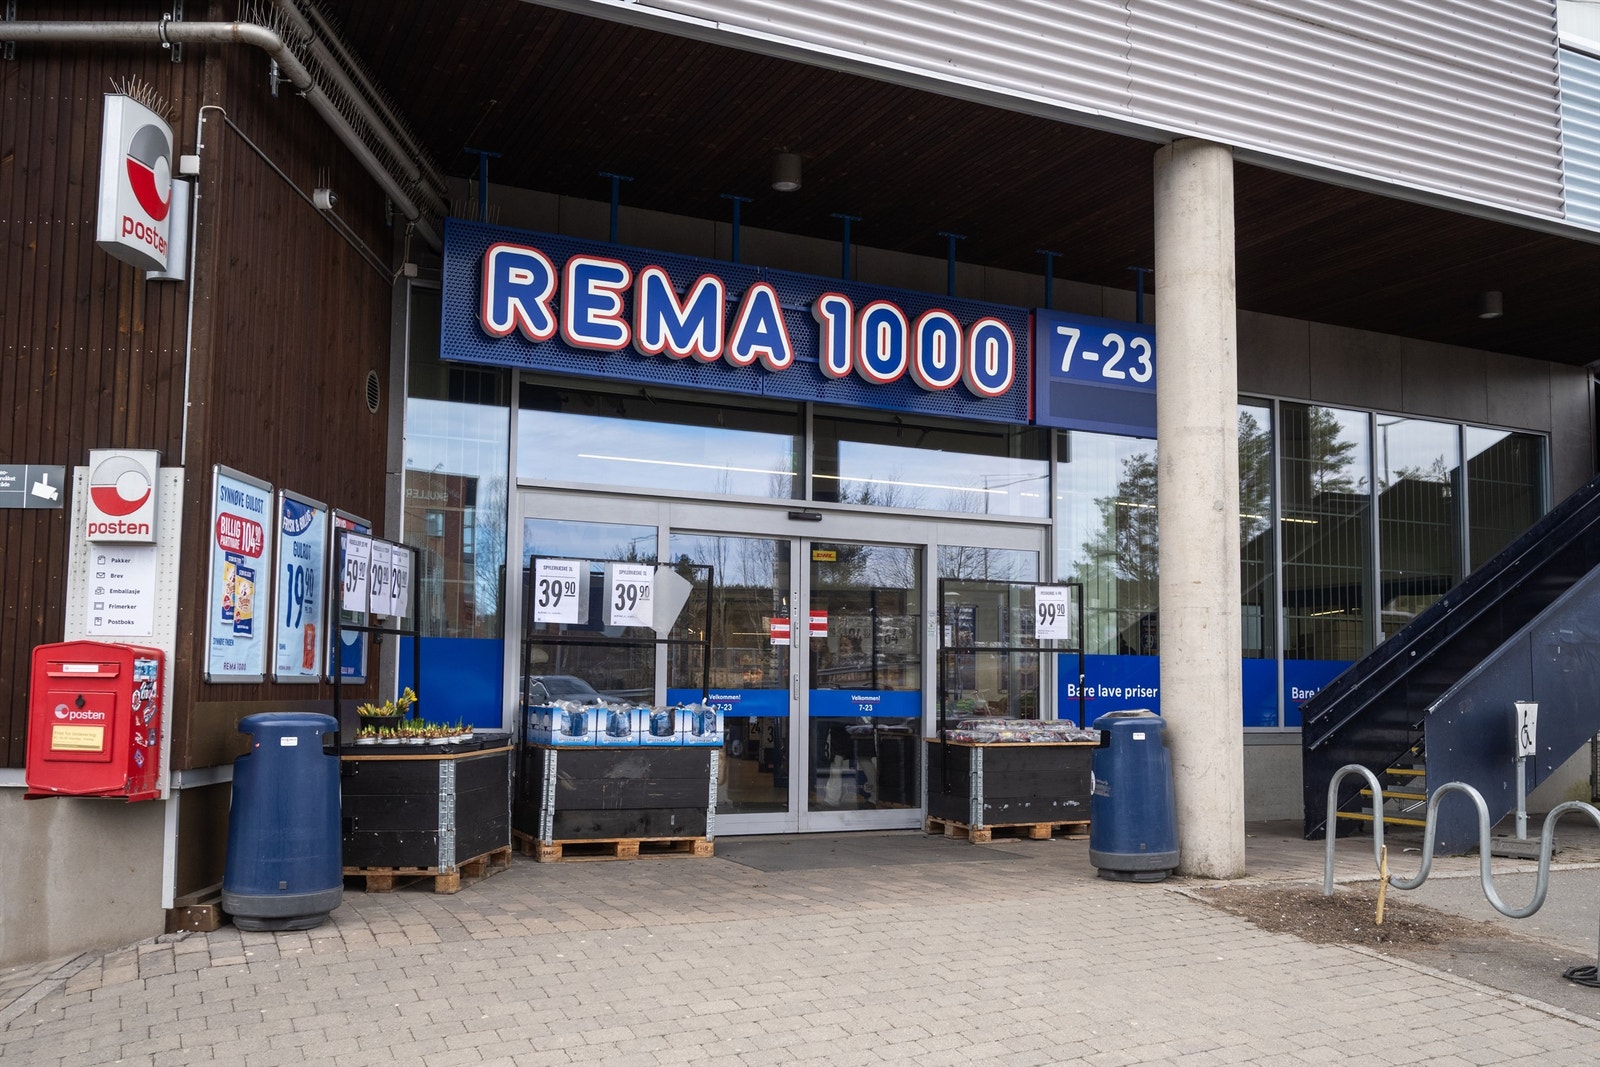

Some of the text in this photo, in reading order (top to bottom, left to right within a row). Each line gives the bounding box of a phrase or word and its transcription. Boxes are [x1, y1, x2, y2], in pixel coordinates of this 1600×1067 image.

[122, 214, 168, 258] posten
[482, 241, 1016, 397] REMA 1000
[1057, 325, 1153, 383] 7-23
[220, 485, 244, 508] SYNNØVE
[88, 519, 149, 537] posten
[220, 515, 241, 539] BILLIG
[346, 558, 359, 593] 59
[371, 563, 383, 596] 29
[286, 563, 305, 629] 19
[538, 579, 563, 608] 39
[614, 583, 638, 611] 39
[1038, 602, 1056, 626] 99
[1098, 684, 1122, 697] lave
[1124, 684, 1158, 700] priser
[1291, 686, 1315, 699] Bare
[69, 710, 106, 720] posten
